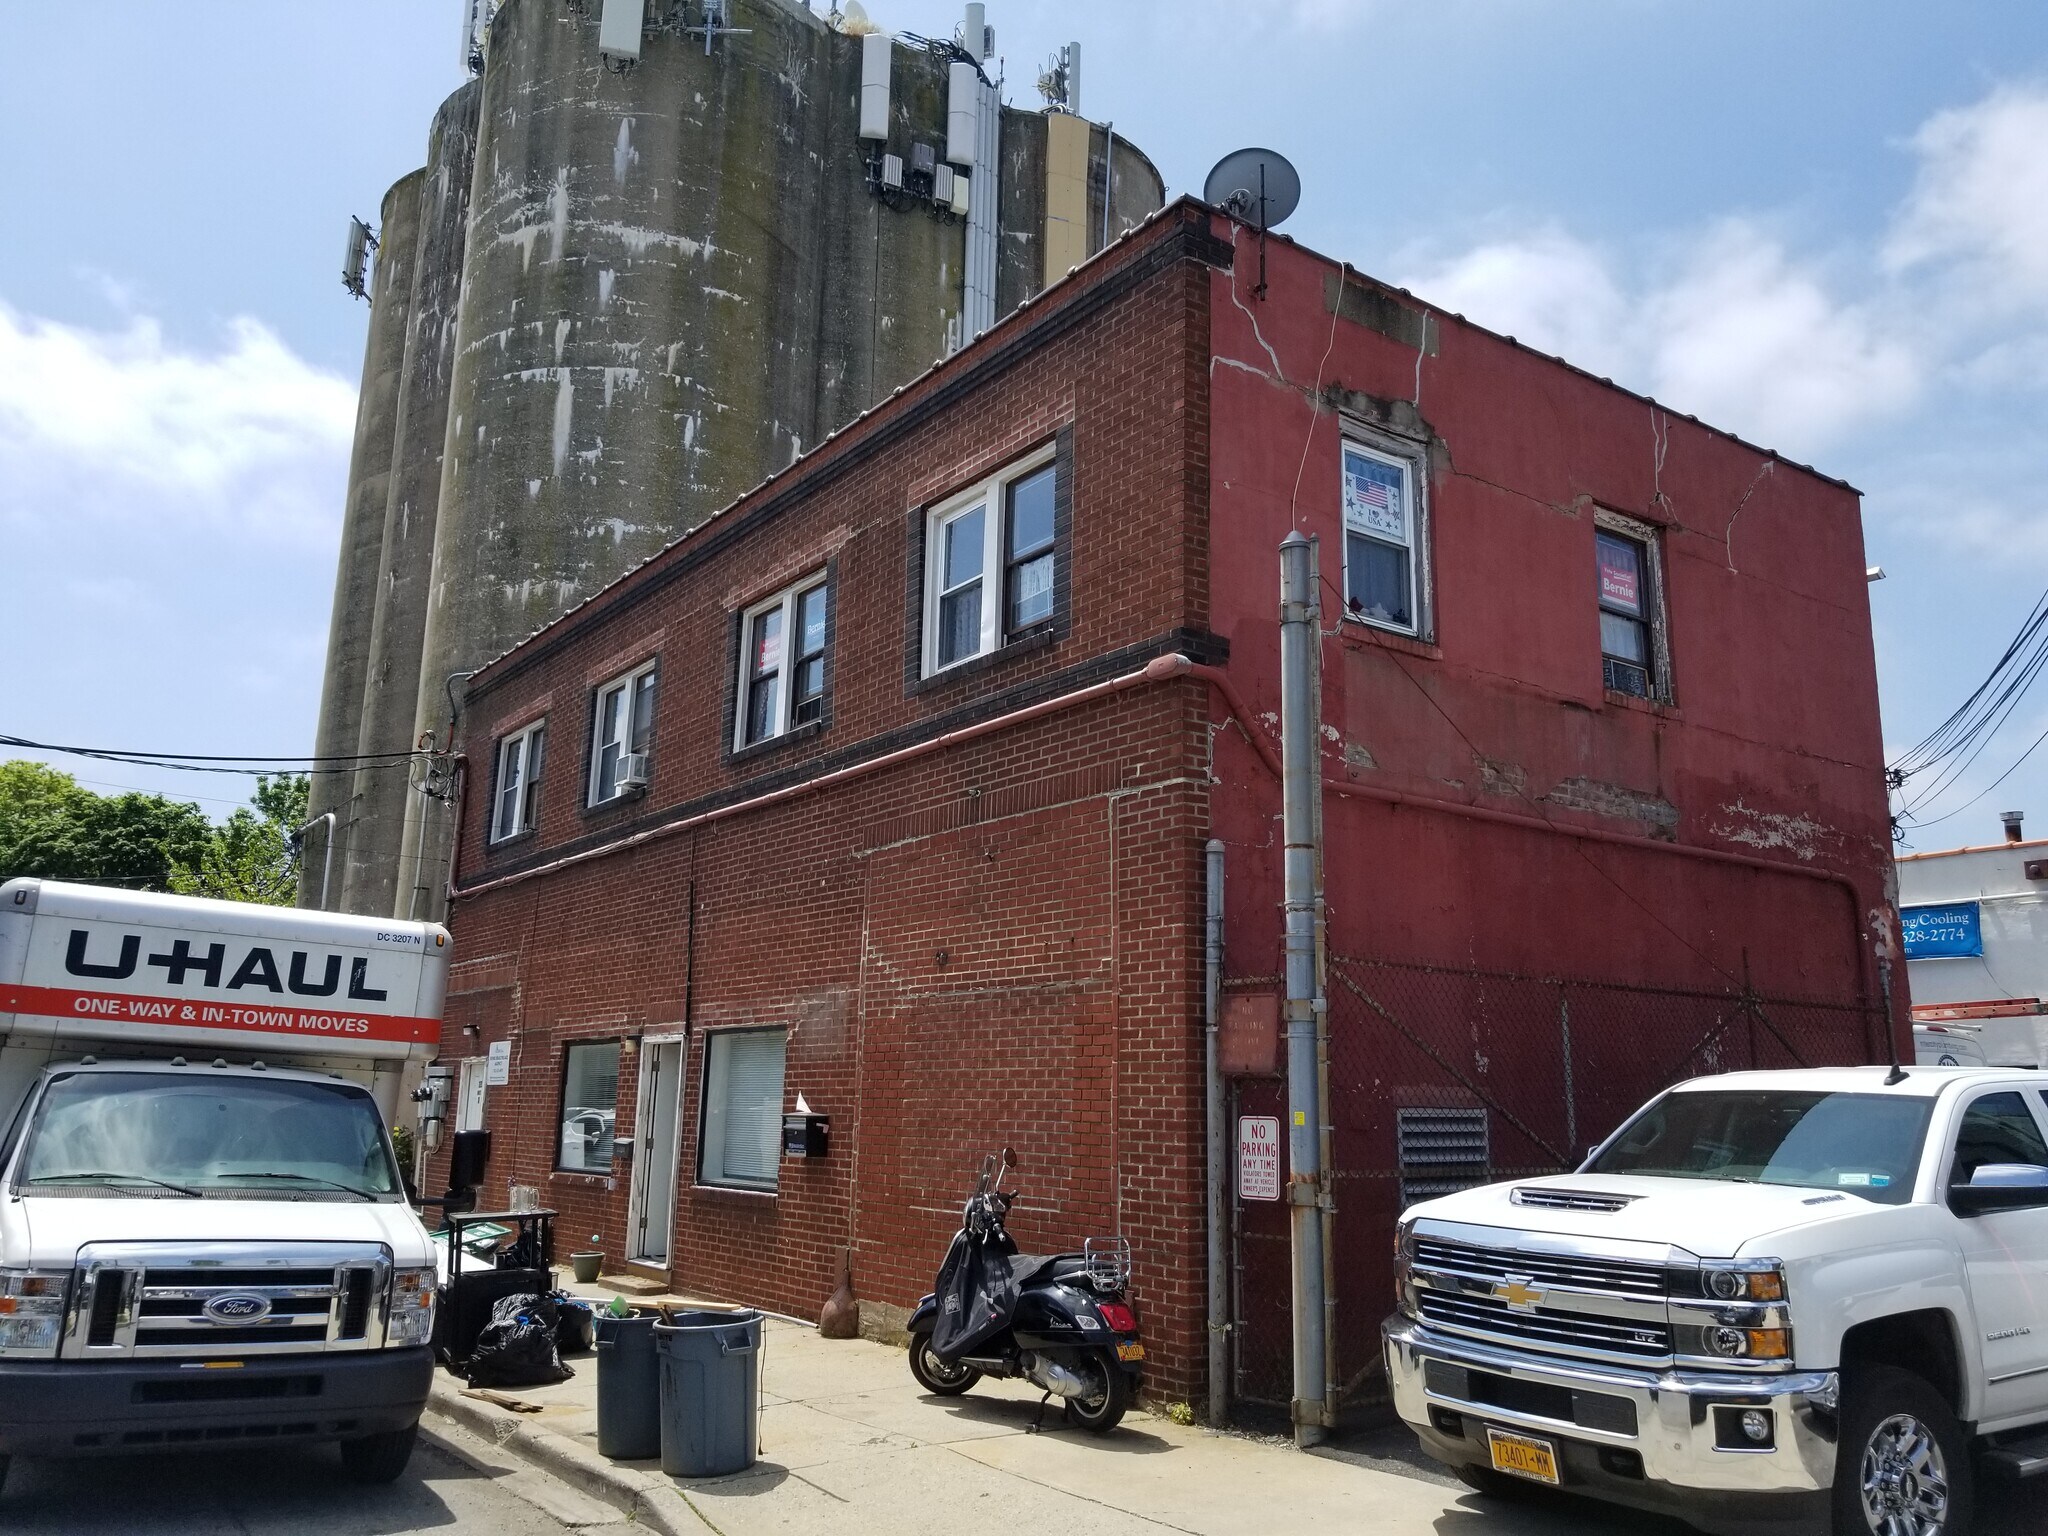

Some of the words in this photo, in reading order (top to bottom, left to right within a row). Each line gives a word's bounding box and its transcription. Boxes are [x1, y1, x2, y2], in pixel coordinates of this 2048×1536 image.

[1368, 516, 1382, 527] USA
[1603, 577, 1634, 599] Bernie
[377, 932, 391, 942] DC
[392, 934, 412, 944] 3207
[414, 936, 421, 944] N
[65, 929, 388, 1002] U-HAUL
[74, 997, 176, 1018] ONE-WAY
[180, 1004, 197, 1020] &
[202, 1007, 294, 1028] IN-TOWN
[298, 1013, 370, 1034] MOVES
[1251, 1124, 1266, 1139] NO
[1242, 1142, 1276, 1158] PARKING
[1243, 1159, 1257, 1169] ANY
[1260, 1160, 1275, 1171] TIME
[1243, 1170, 1262, 1178] VIOLATORS
[1260, 1178, 1275, 1186] VEHICLE
[1259, 1186, 1275, 1194] EXPENSE
[223, 1300, 254, 1314] Ford
[1635, 1332, 1656, 1343] LTZ
